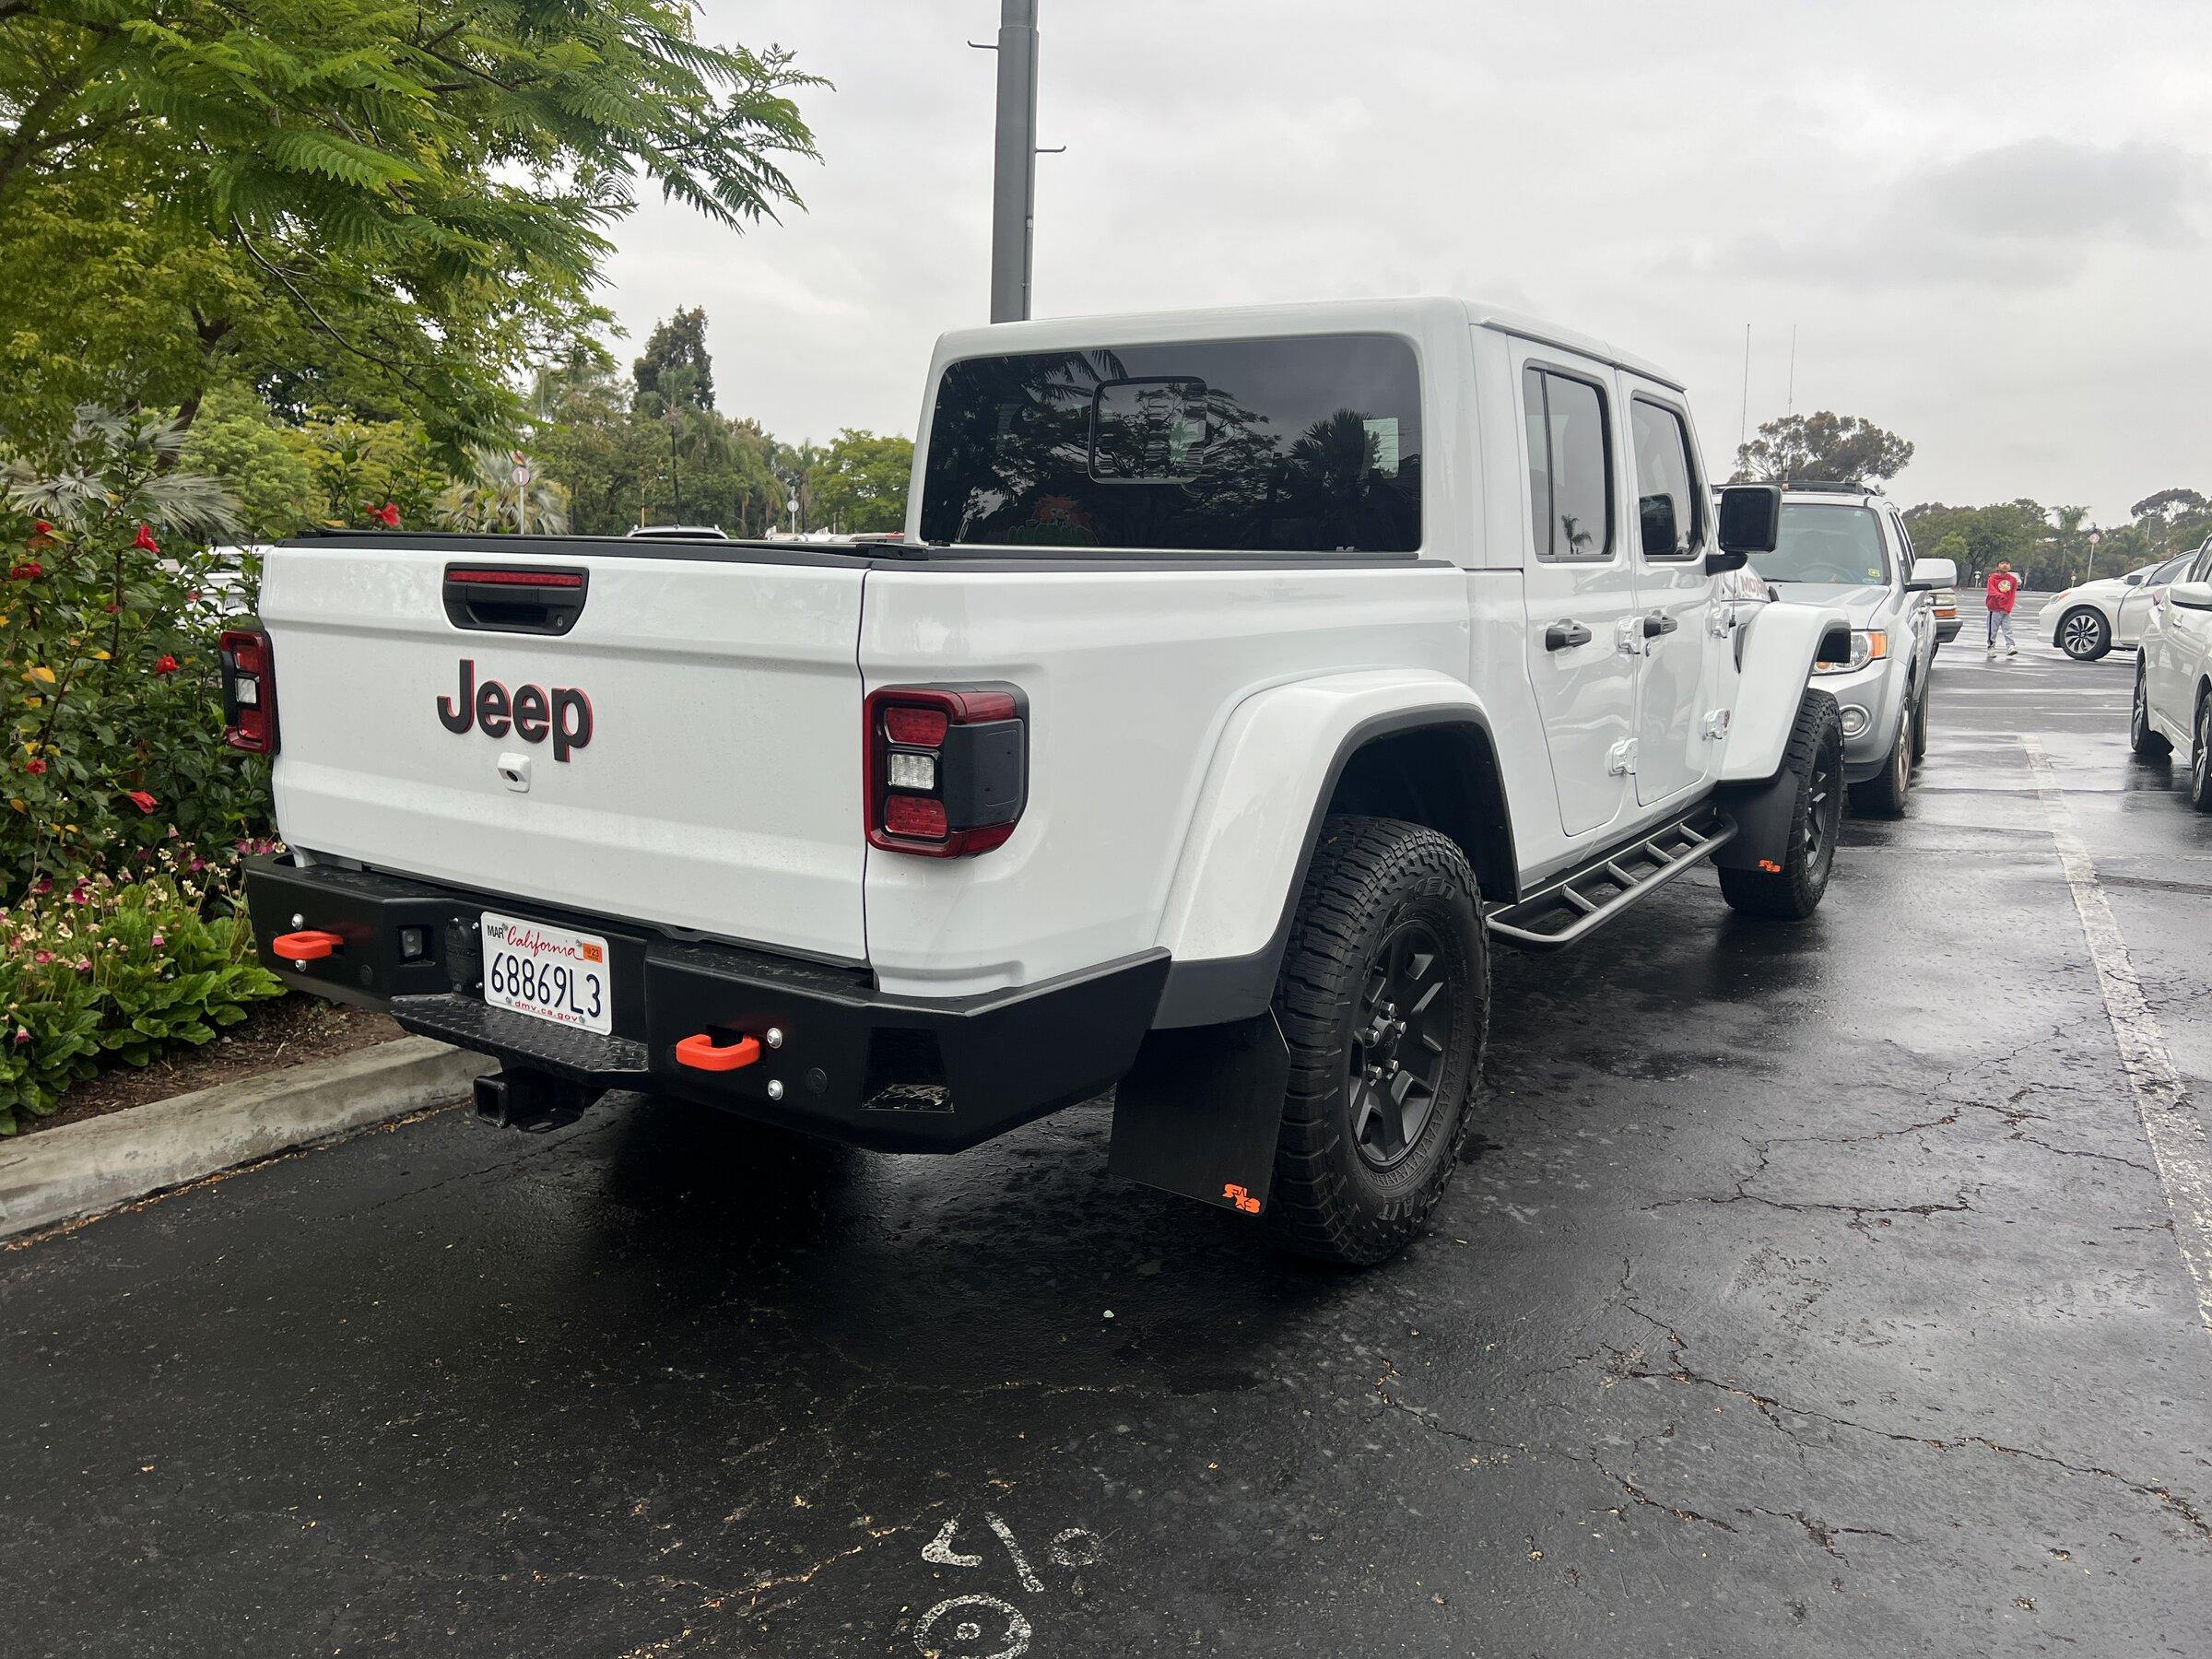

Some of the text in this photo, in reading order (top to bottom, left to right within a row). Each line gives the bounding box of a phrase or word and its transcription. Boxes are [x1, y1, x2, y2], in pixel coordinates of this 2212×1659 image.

[436, 658, 594, 763] Jeep
[487, 924, 505, 939] MAR
[508, 925, 585, 961] California
[591, 947, 600, 958] 23
[491, 952, 601, 1018] 68869L3
[514, 1000, 579, 1022] dmv.ca.gov
